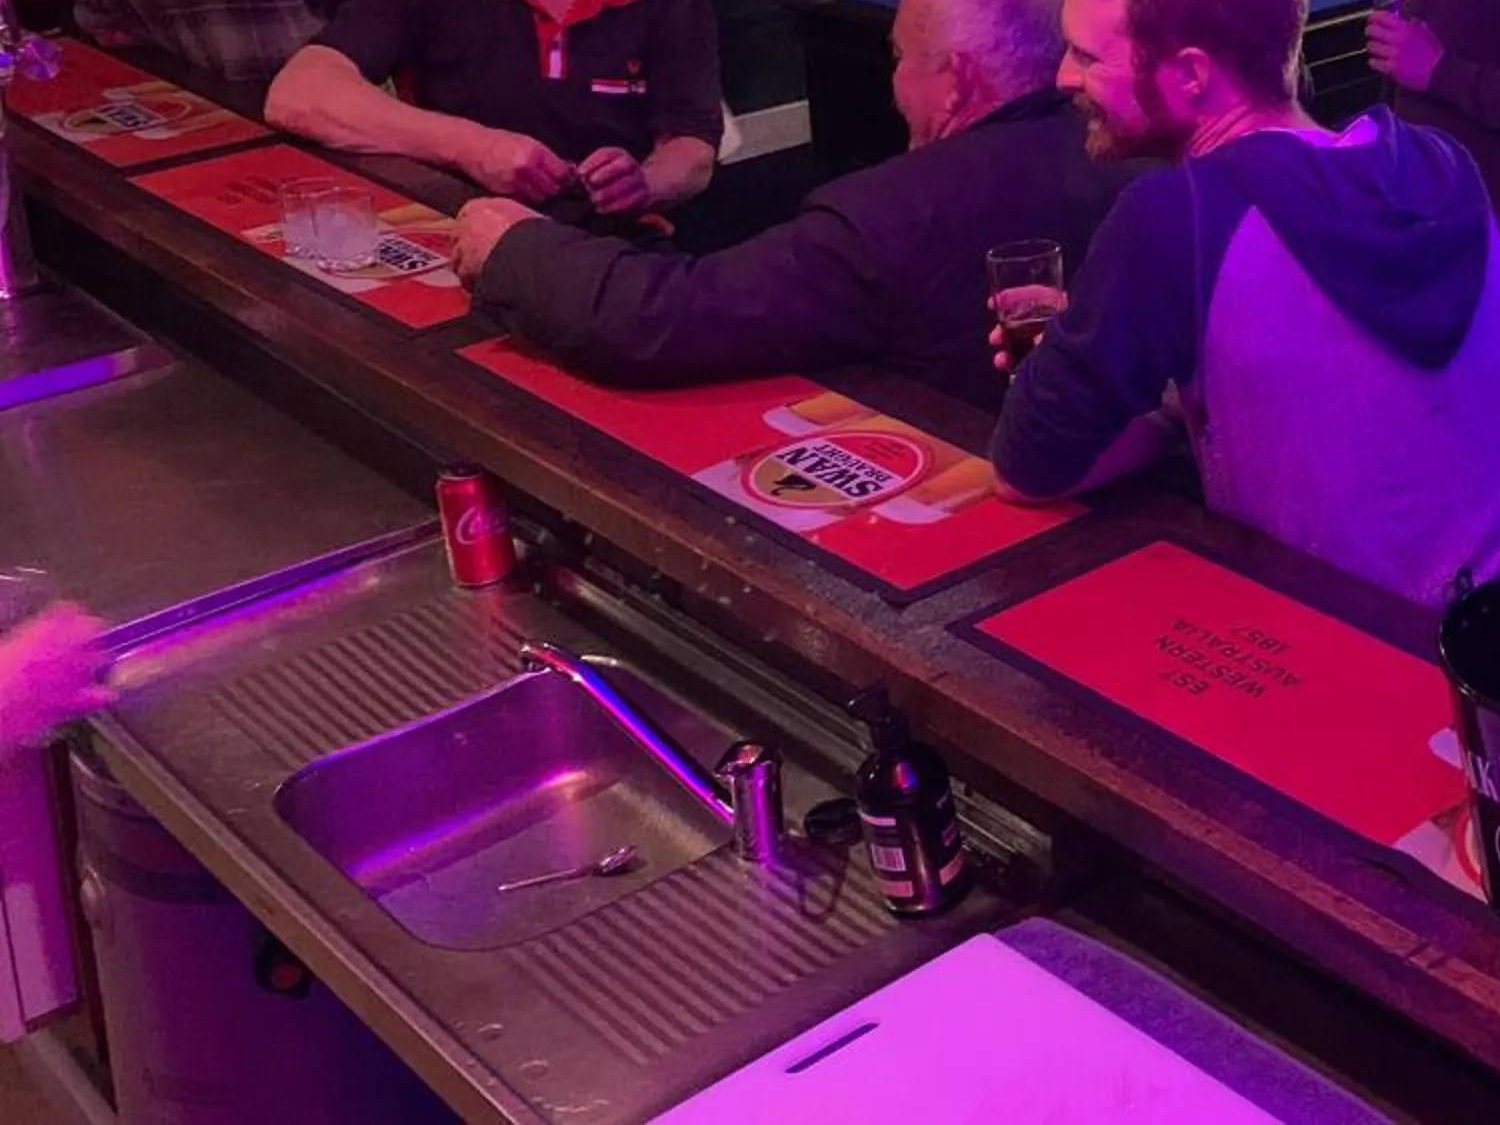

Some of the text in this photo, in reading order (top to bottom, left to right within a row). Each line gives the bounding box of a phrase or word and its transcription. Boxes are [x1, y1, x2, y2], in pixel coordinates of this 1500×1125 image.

[776, 447, 882, 497] SWAN
[812, 444, 892, 481] DRAUGHT
[1156, 635, 1266, 697] WESTERN
[1172, 619, 1300, 687] AUSTRALIA
[1159, 669, 1211, 695] EST
